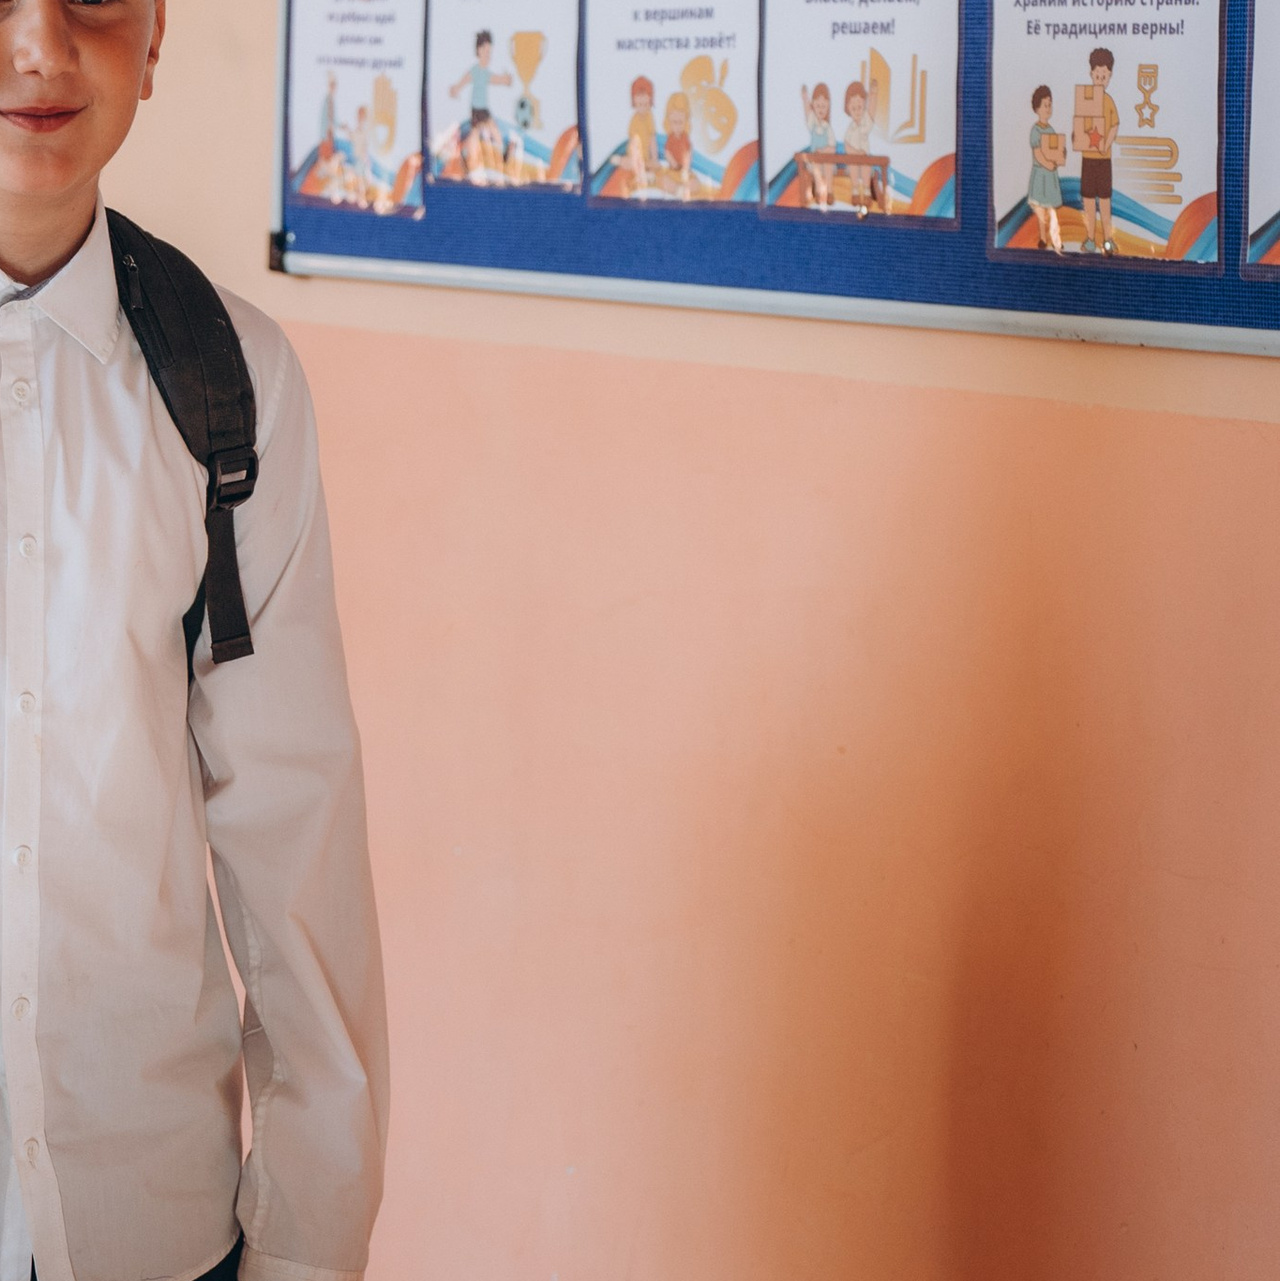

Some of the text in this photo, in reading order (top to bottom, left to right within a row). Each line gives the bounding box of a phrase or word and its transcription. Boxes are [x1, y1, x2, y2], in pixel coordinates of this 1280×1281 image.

[633, 6, 715, 26] к вершинам
[831, 18, 896, 39] решаем!
[1026, 19, 1185, 39] Её традициям верны!
[616, 31, 737, 56] мастерства зовёт!
